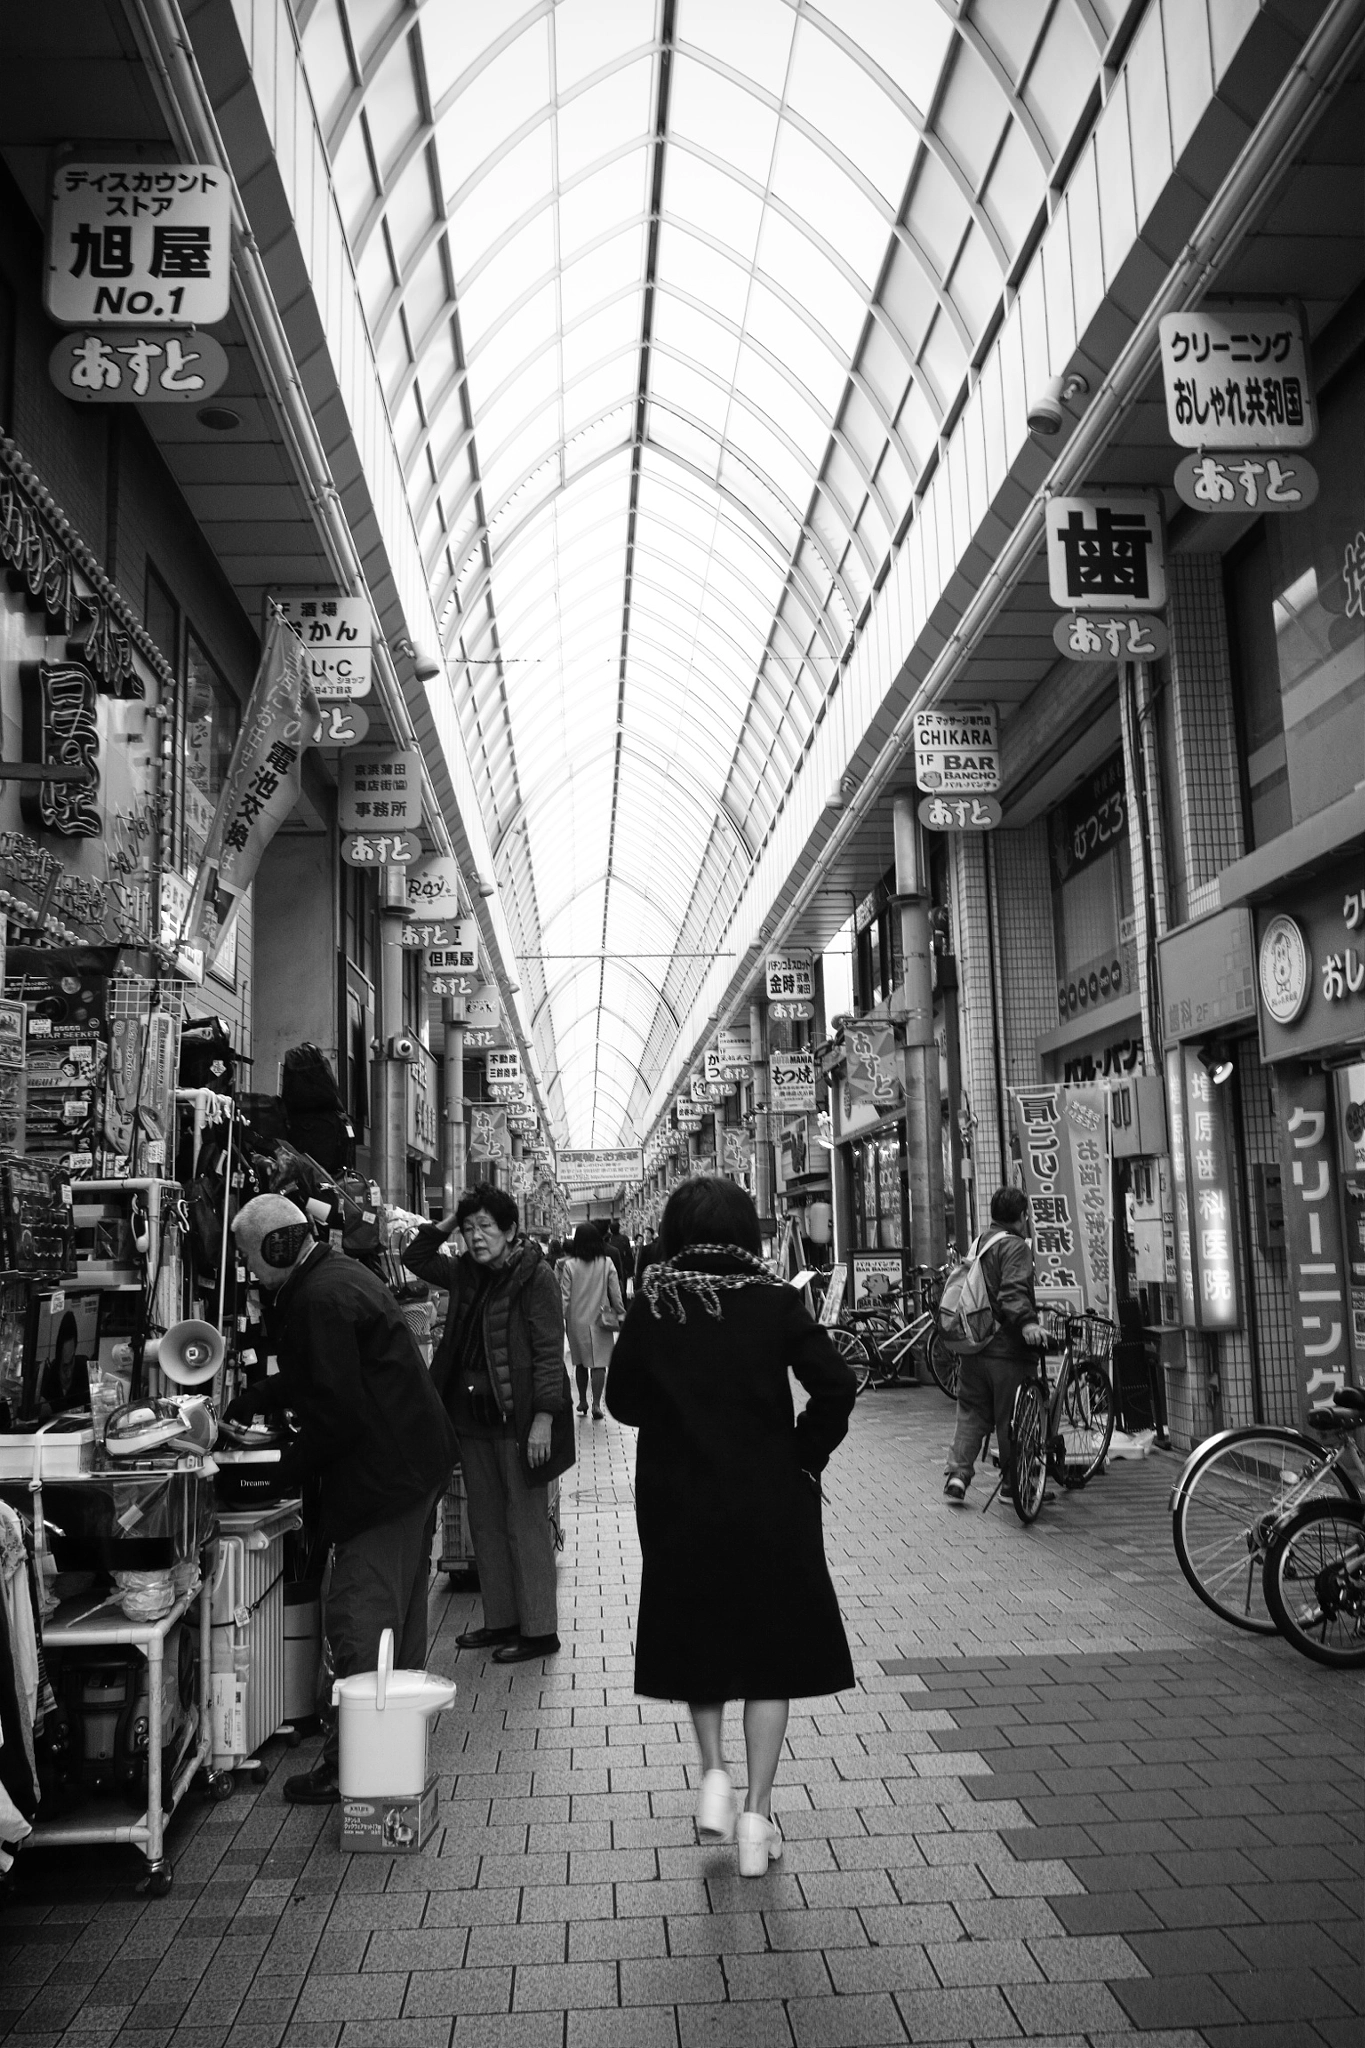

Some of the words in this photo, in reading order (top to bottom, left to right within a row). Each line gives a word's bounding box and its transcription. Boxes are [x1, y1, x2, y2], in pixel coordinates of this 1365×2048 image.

[64, 170, 218, 193] ディスカウント
[106, 196, 174, 217] ストア
[69, 223, 211, 279] 旭屋
[93, 286, 186, 316] No.1
[1172, 330, 1292, 363] クリーニング
[70, 337, 205, 396] あすと
[1174, 377, 1303, 426] おしゃれ共和国
[1192, 458, 1302, 507] あすと
[1068, 617, 1156, 657] あすと
[917, 715, 933, 725] 2F
[920, 730, 992, 745] CHIKARA
[919, 754, 934, 765] 1F
[943, 755, 995, 769] BAR
[944, 772, 996, 780] BANCHO
[354, 801, 407, 817] 事務所
[928, 798, 992, 828] あすと
[351, 835, 411, 863] あすと
[402, 925, 449, 947] あすと
[429, 951, 474, 968] 但馬屋
[431, 976, 472, 997] あすと
[774, 1002, 809, 1020] あすと
[35, 1031, 61, 1040] STAR
[63, 1030, 100, 1038] SEEKER
[462, 1031, 495, 1047] あすと
[852, 1031, 894, 1099] あすと
[1288, 1106, 1346, 1410] クリーニング
